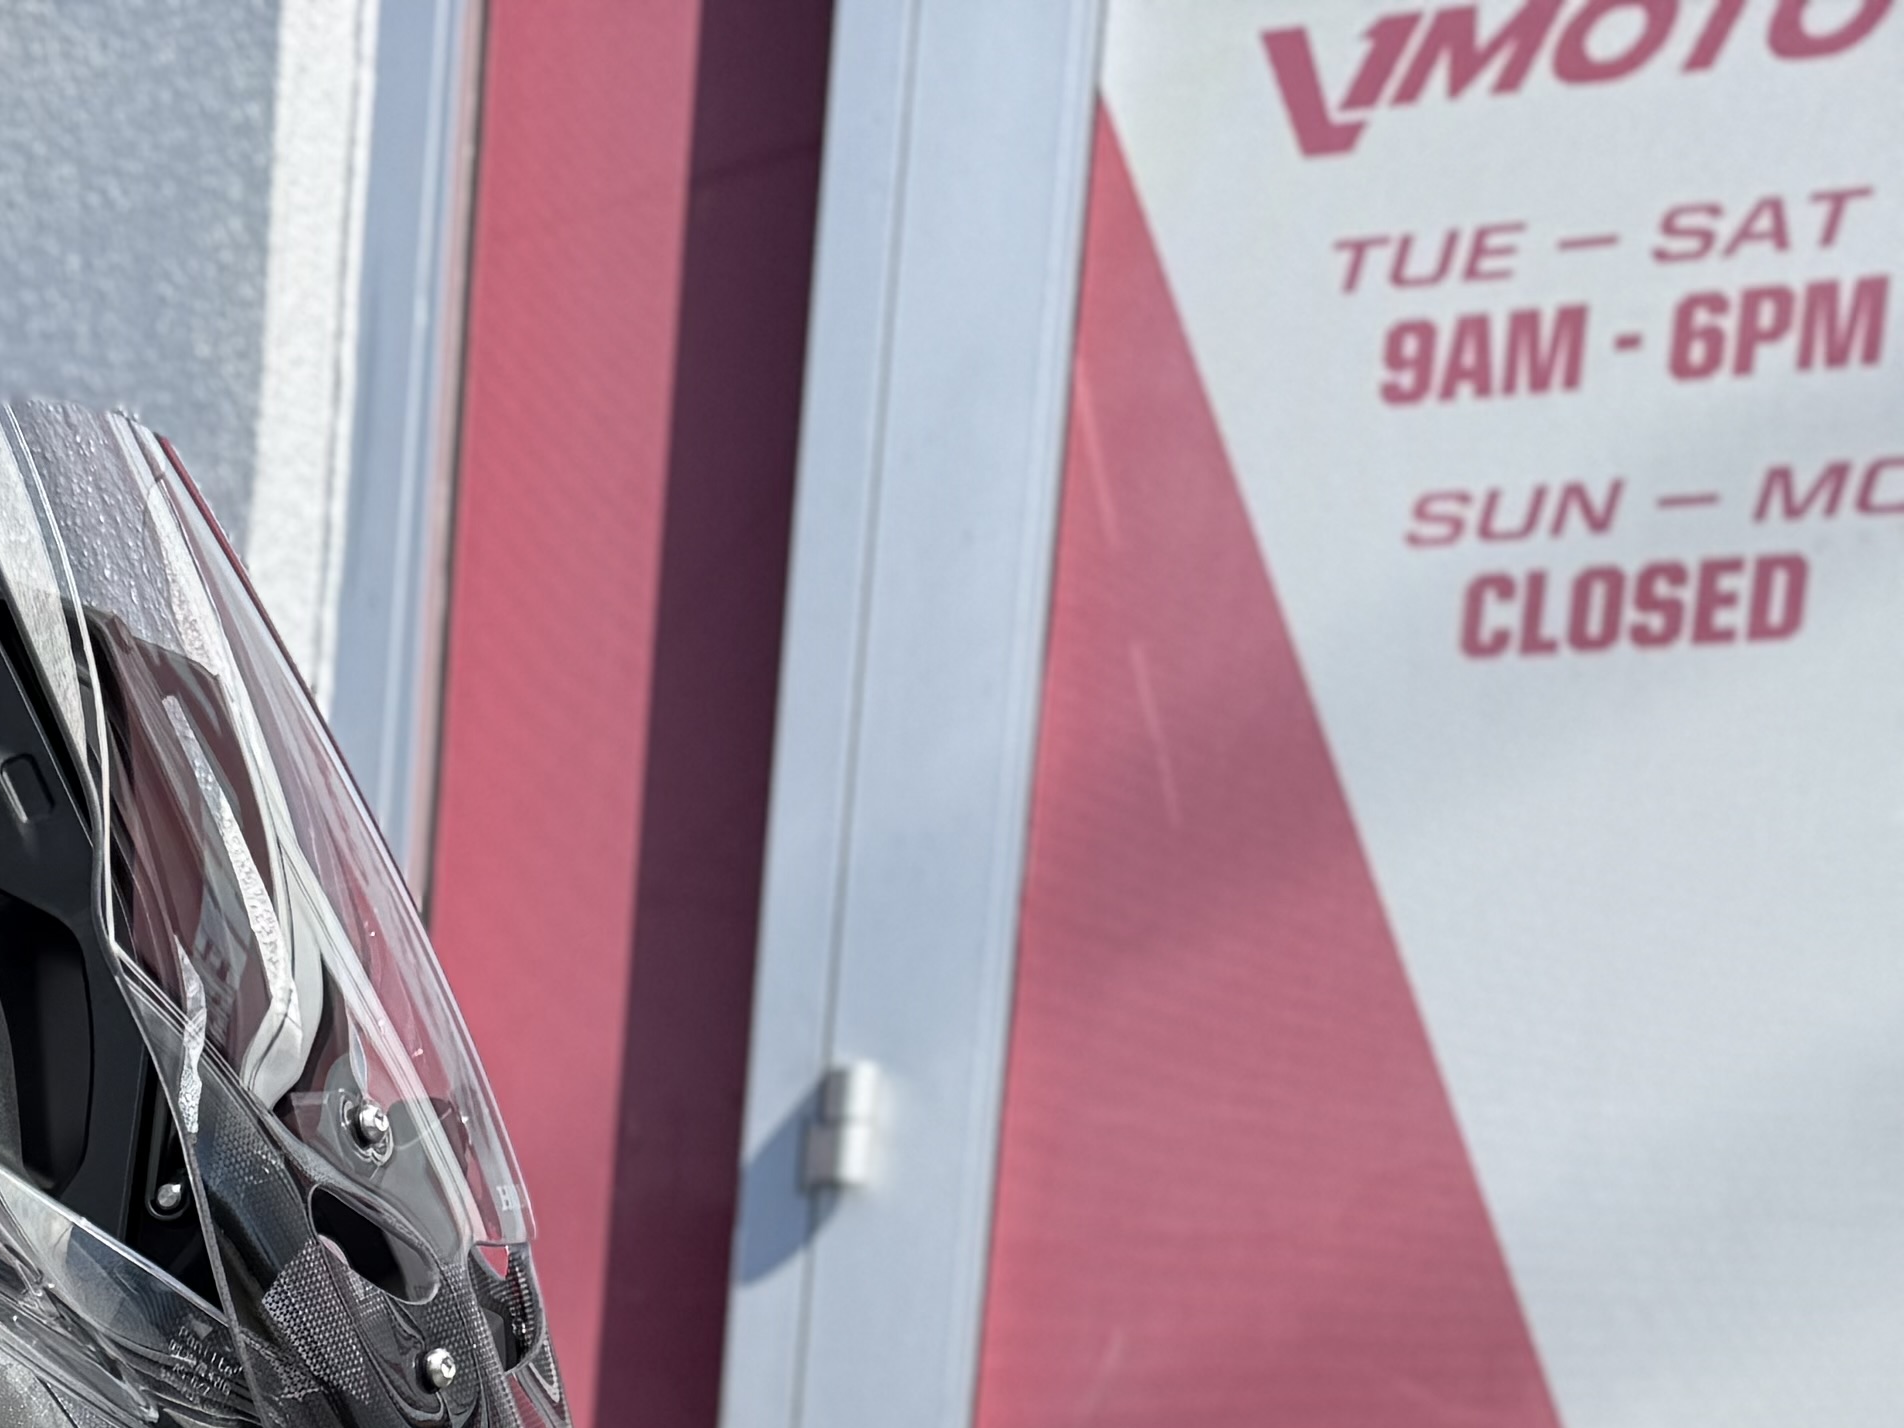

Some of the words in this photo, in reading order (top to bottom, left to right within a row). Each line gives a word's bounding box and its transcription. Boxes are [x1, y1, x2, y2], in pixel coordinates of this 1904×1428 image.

[1335, 224, 1526, 294] TUE
[1652, 187, 1874, 263] SAT
[1379, 303, 1590, 408] 9AM
[1667, 274, 1890, 383] 6PM
[1405, 478, 1625, 549] SUN
[1458, 553, 1810, 661] CLOSED
